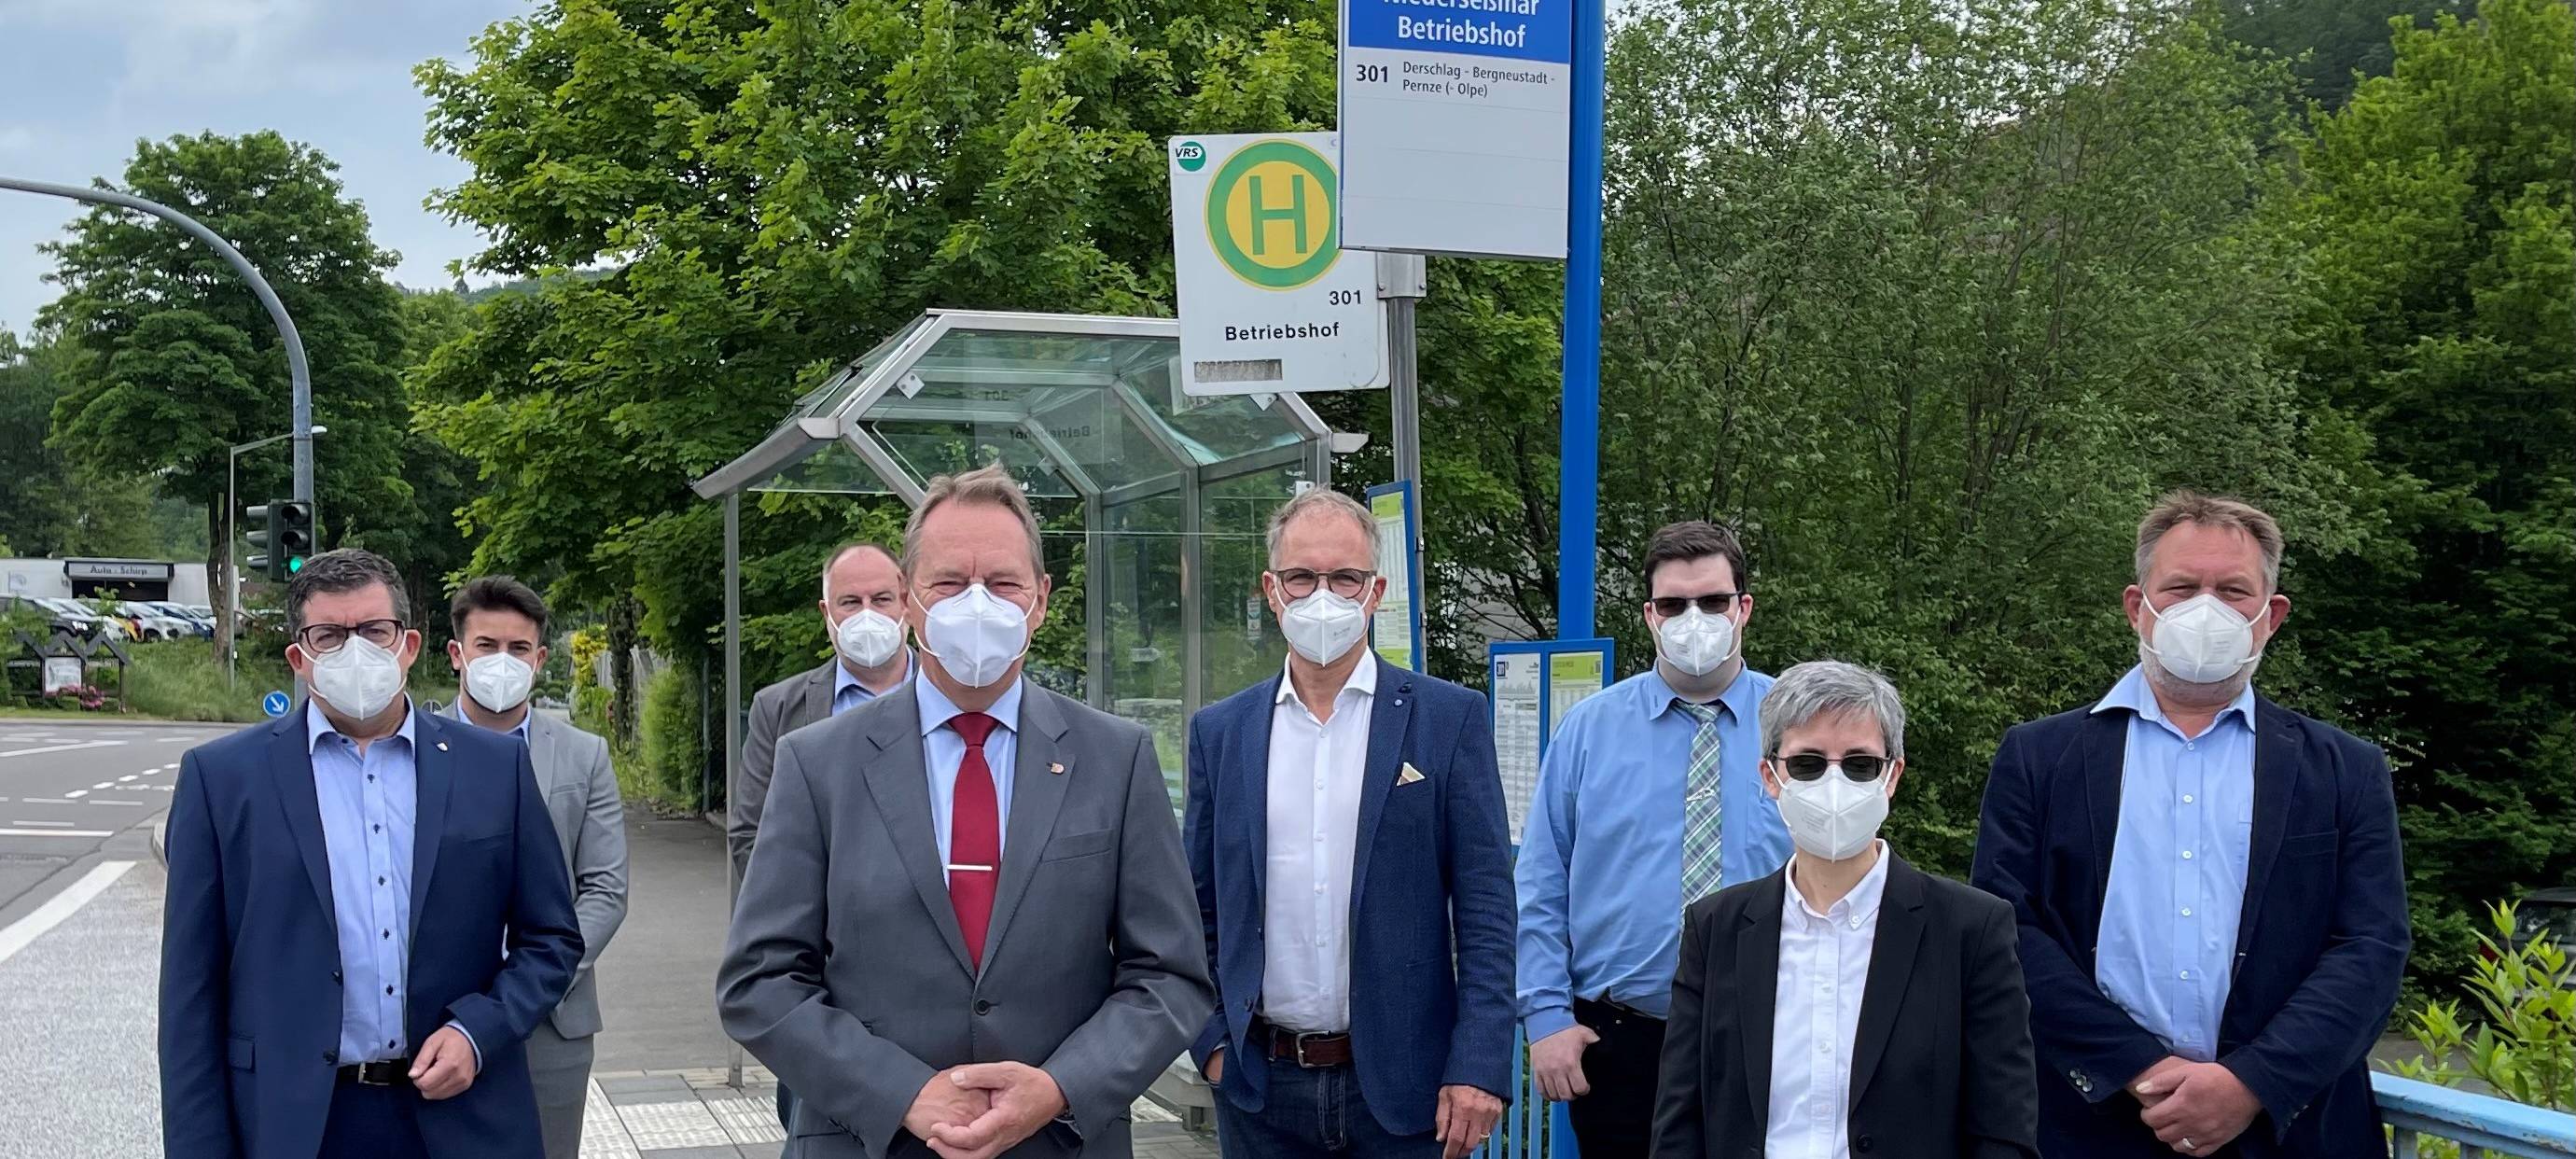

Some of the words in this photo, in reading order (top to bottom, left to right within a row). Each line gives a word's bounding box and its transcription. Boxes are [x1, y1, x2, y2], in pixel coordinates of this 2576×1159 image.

[1399, 15, 1526, 48] Betriebshof
[1356, 63, 1389, 83] 301
[1403, 61, 1461, 80] Derschlag
[1472, 66, 1548, 85] Bergneustadt
[1403, 79, 1442, 93] Pernze
[1457, 82, 1488, 99] Olpe)
[1175, 147, 1199, 158] VRS
[1248, 174, 1307, 256] H
[1329, 289, 1361, 306] 301
[1225, 321, 1340, 342] Betriebshof
